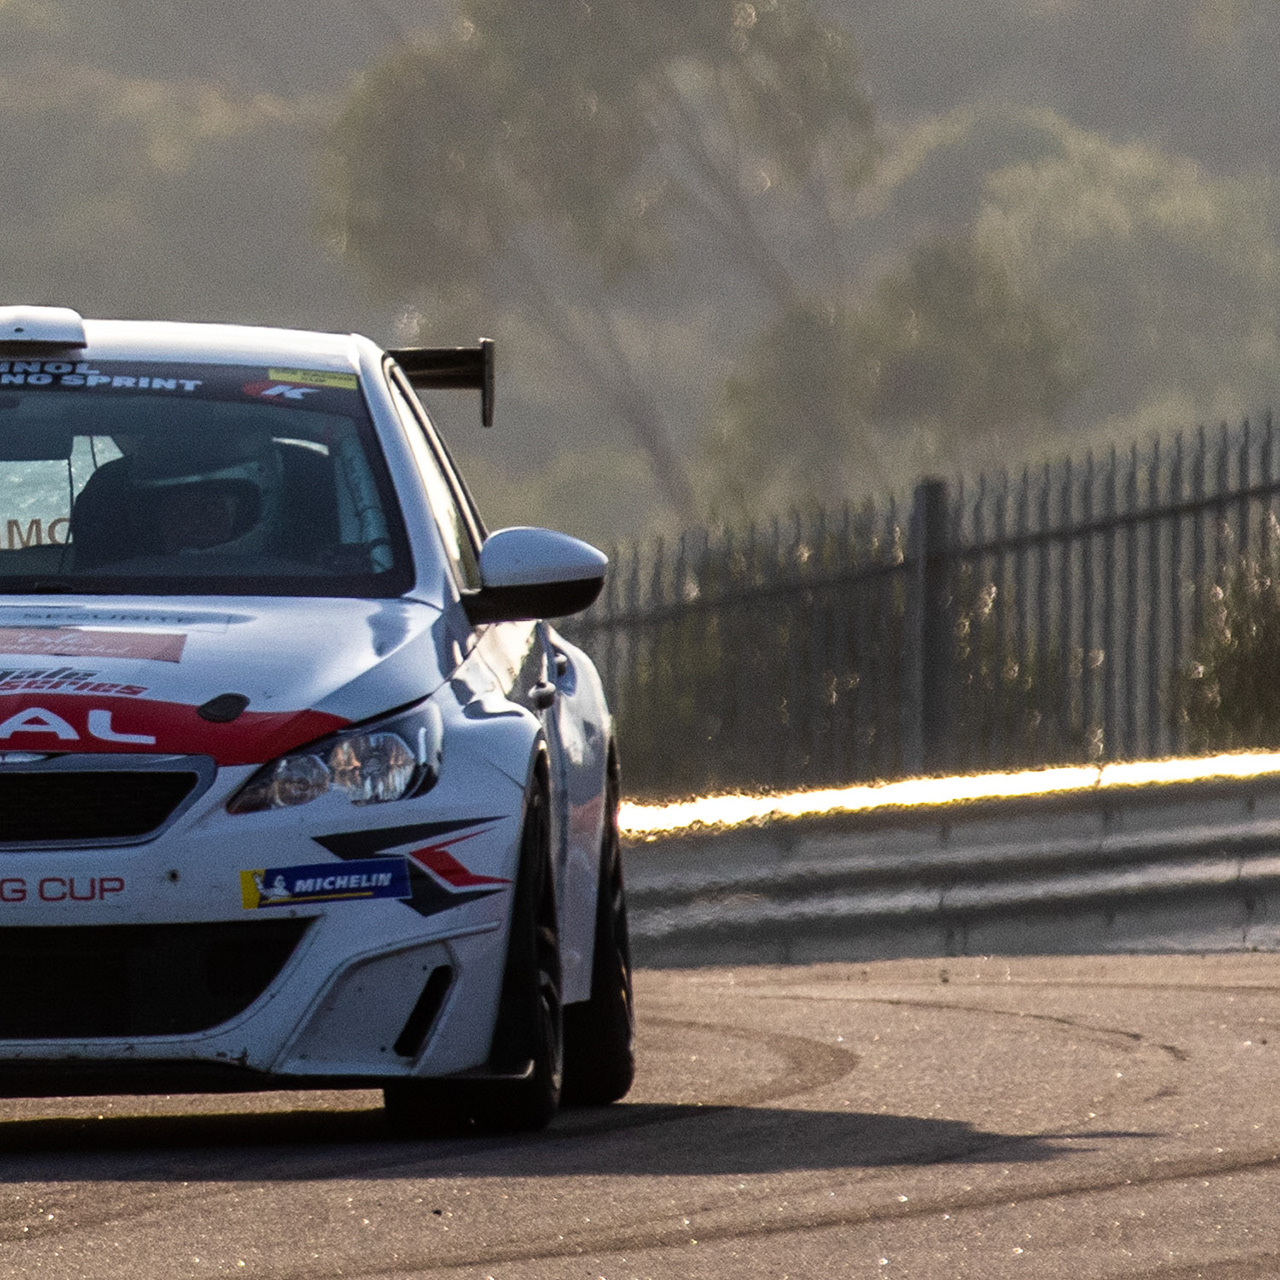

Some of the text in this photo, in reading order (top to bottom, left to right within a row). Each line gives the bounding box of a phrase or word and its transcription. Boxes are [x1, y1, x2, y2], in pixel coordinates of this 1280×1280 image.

[60, 374, 203, 391] SPRINT
[38, 877, 126, 902] CUP
[293, 872, 393, 894] MICHELIN
